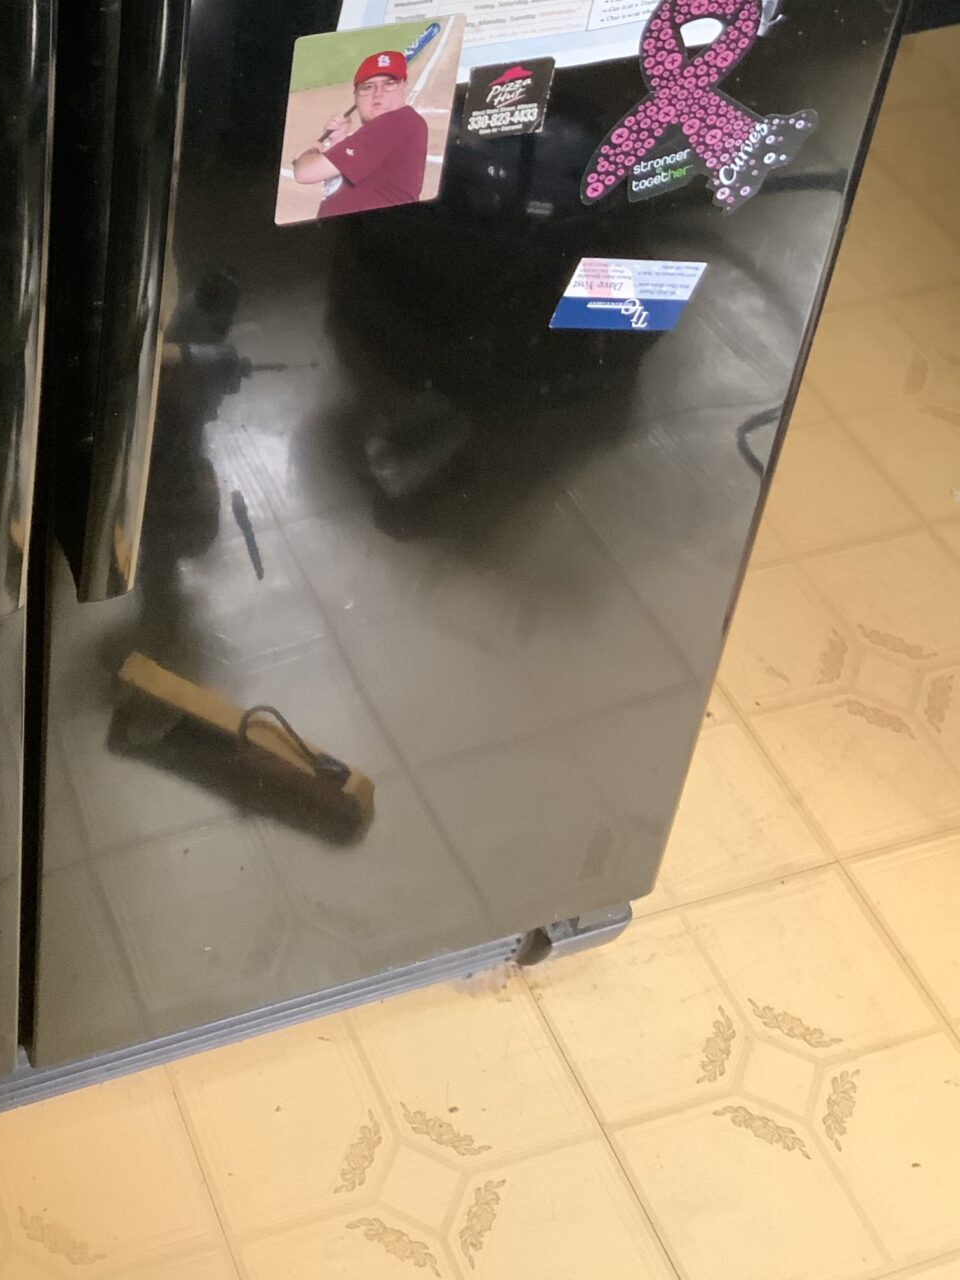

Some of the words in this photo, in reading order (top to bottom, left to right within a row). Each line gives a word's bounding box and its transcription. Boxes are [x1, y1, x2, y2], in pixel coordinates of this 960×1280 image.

[486, 78, 532, 103] Pizza
[493, 88, 526, 107] Hut
[467, 108, 538, 131] 330-823-4433
[719, 122, 768, 185] Curves
